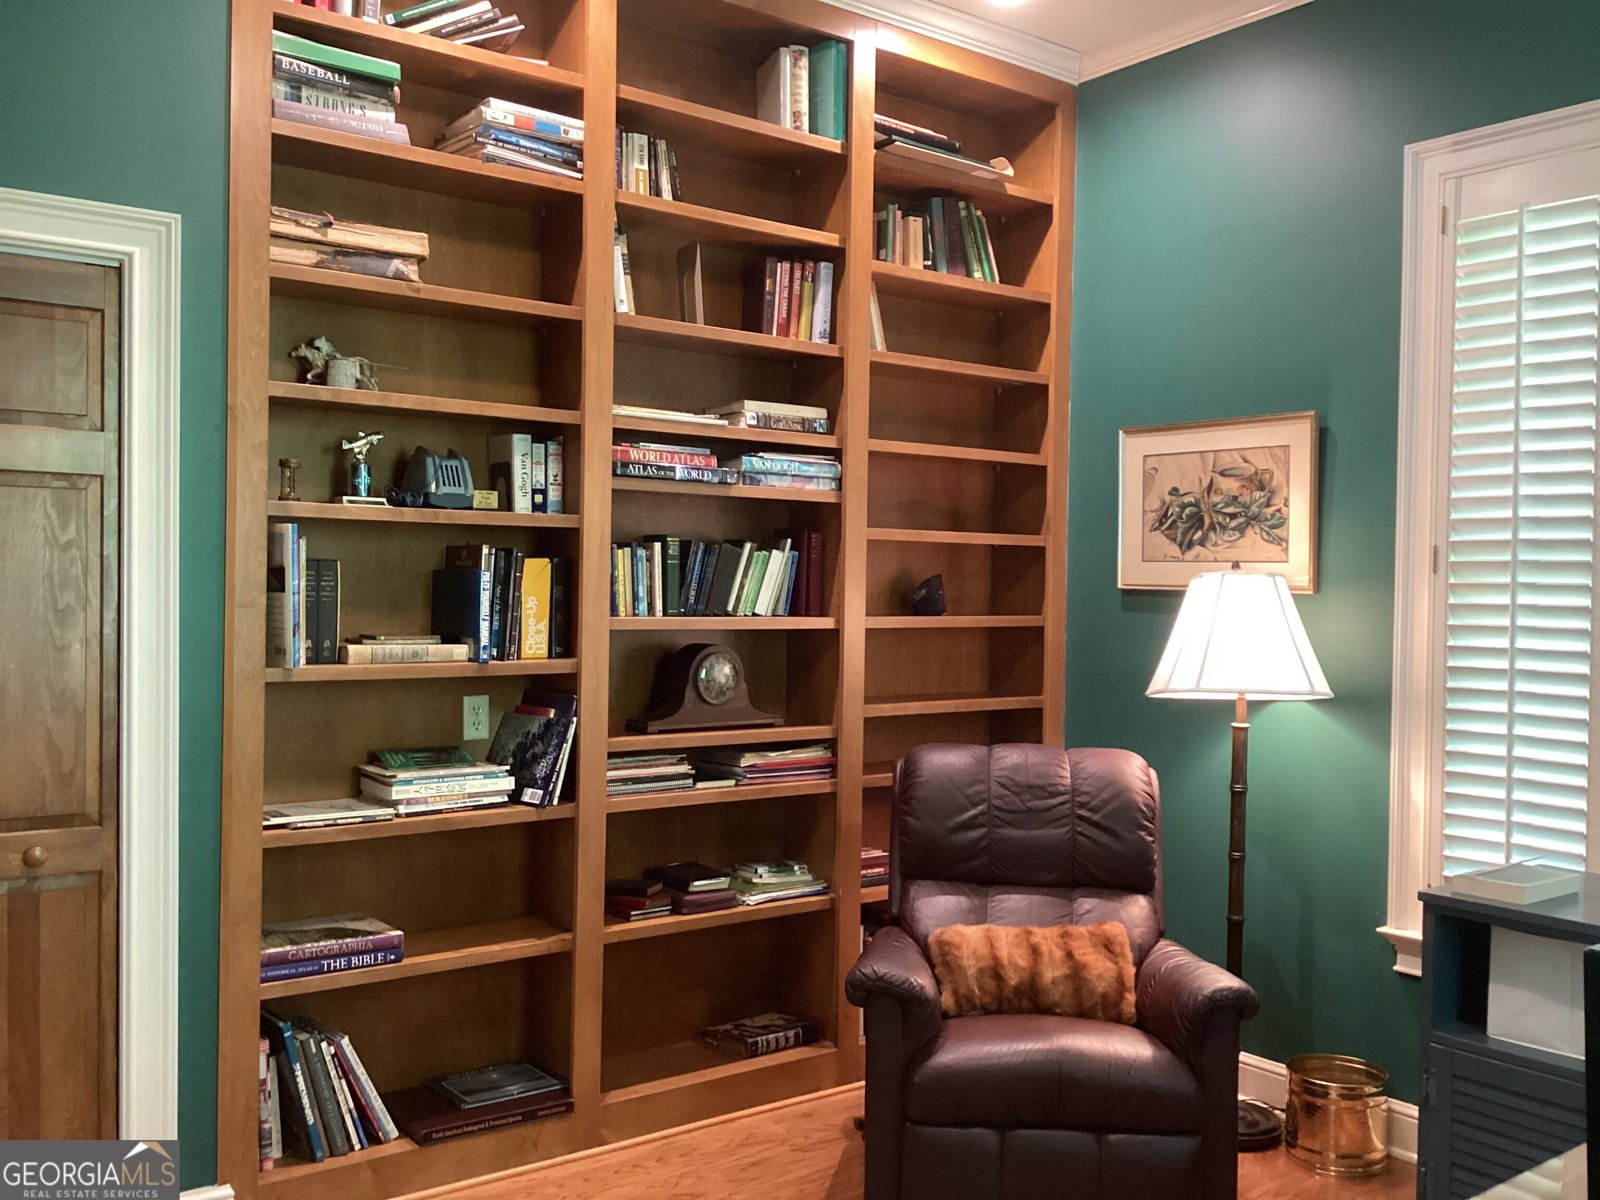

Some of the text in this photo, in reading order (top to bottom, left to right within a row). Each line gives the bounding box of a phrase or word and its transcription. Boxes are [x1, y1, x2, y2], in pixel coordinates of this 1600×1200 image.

[281, 57, 350, 85] BASEBALL
[305, 93, 367, 117] STRONG'S
[629, 449, 706, 467] WORLD ATLAS
[752, 457, 772, 469] VAN
[626, 463, 658, 476] ATLAS
[677, 467, 712, 481] WORLD
[519, 472, 530, 497] Gogh
[525, 596, 538, 654] Close-Up
[288, 940, 373, 960] CARTOGRAPHIA
[320, 958, 348, 972] THE
[351, 952, 385, 967] BIBLE
